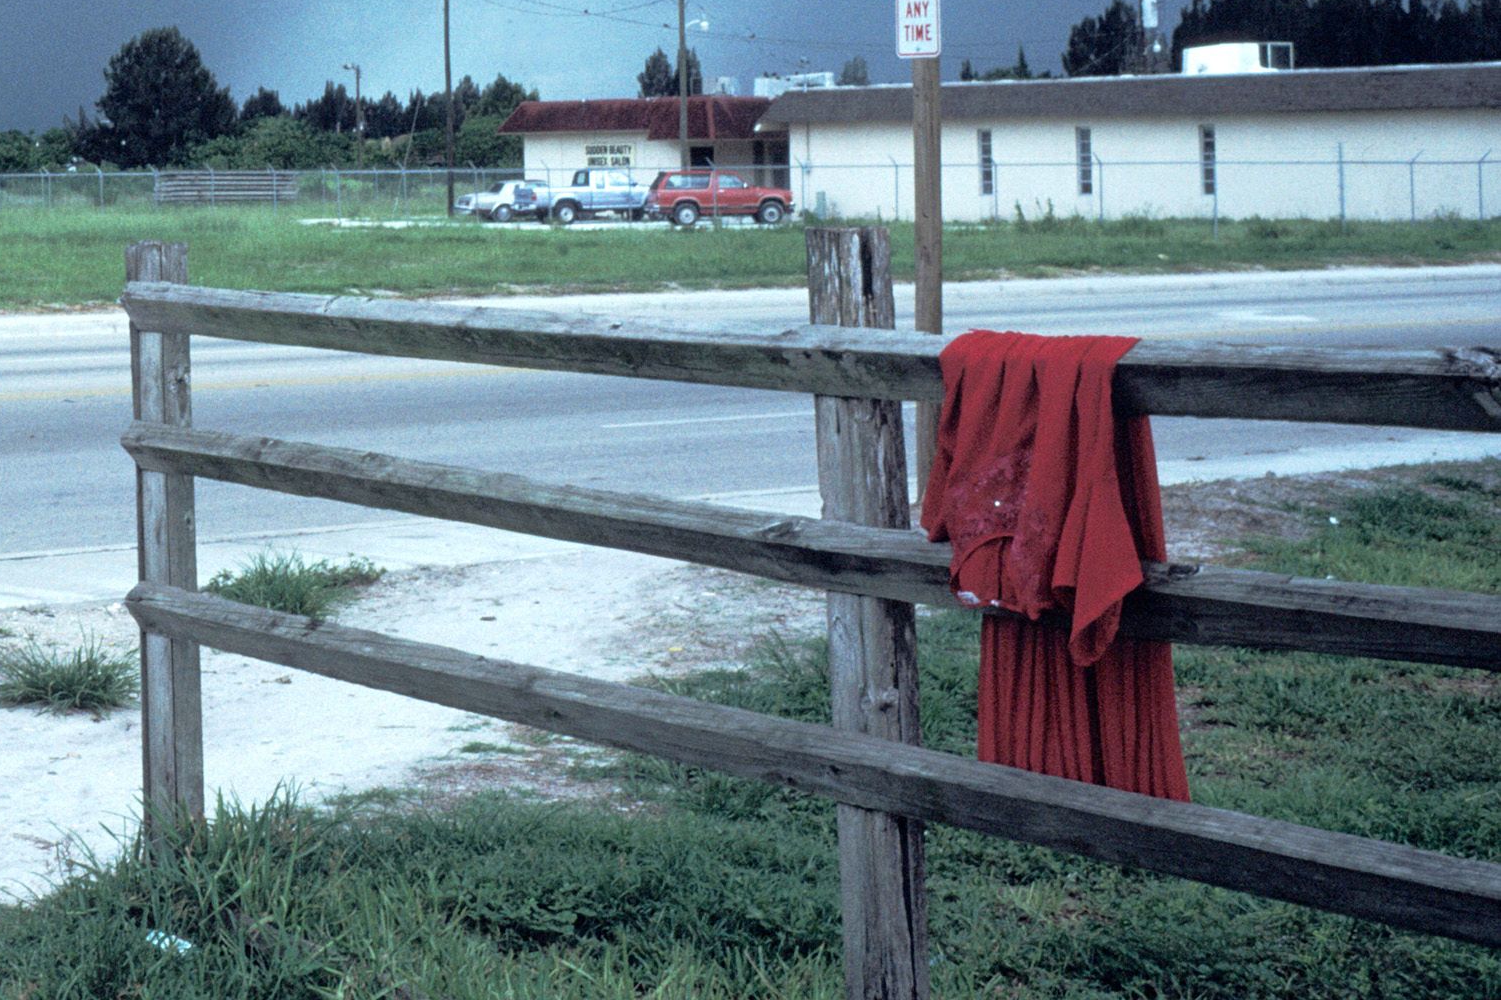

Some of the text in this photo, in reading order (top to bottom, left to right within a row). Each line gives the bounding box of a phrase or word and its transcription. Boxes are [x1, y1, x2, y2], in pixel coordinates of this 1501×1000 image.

[906, 1, 929, 18] ANY
[904, 24, 932, 41] TIME
[609, 144, 632, 155] BEAUTY
[587, 156, 630, 167] UNISEX SALON
